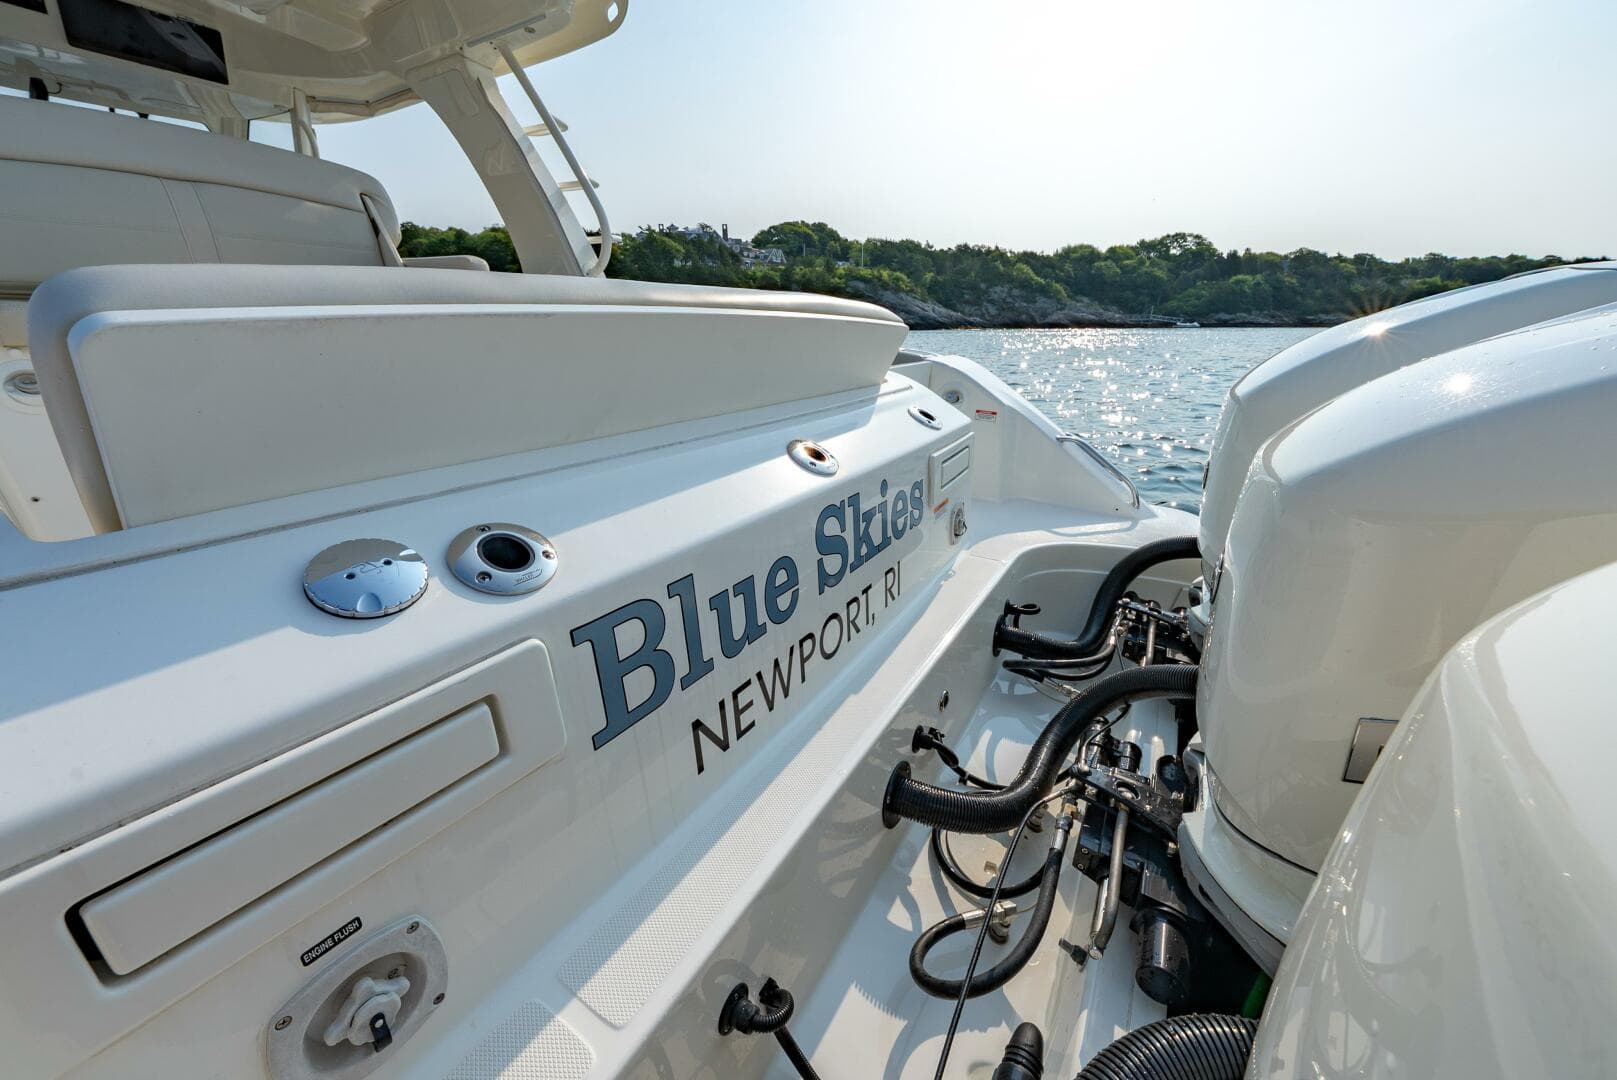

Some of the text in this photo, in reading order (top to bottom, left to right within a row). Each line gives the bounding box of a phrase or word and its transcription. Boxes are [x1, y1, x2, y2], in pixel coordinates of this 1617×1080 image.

[570, 479, 924, 750] Blue Skies
[691, 560, 901, 775] NEWPORT, RI
[303, 920, 360, 963] ENGINE FLUSH
